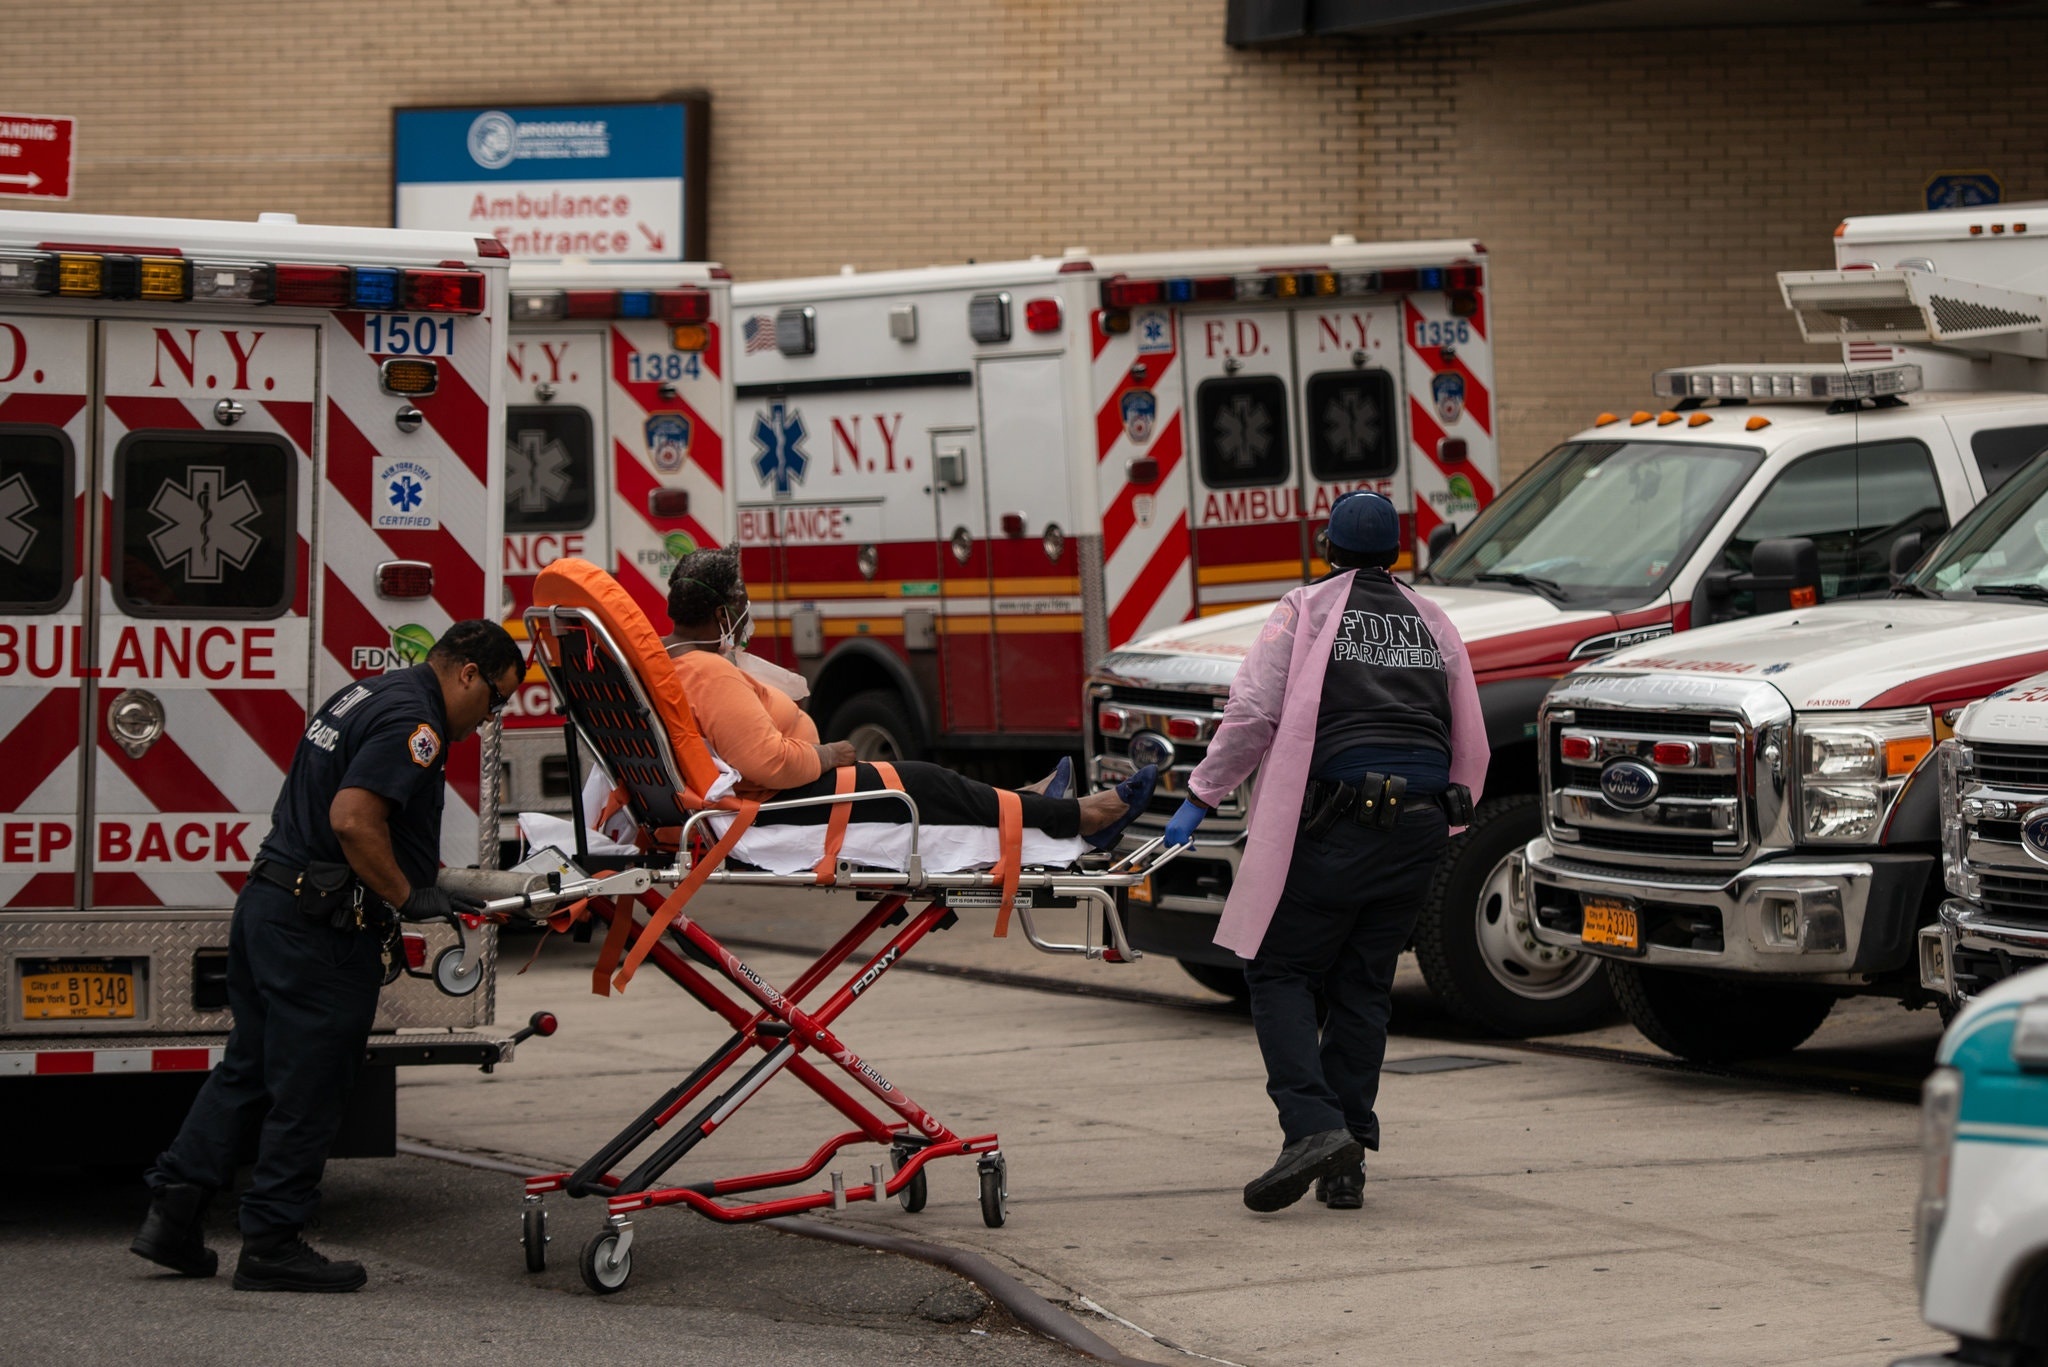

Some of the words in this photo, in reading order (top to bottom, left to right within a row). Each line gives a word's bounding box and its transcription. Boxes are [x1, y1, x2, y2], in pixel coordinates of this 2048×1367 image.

[470, 191, 630, 220] Ambulance
[493, 227, 630, 255] Entrance
[365, 314, 454, 356] 1501
[1204, 318, 1270, 358] F.D.
[1318, 312, 1381, 352] N.Y.
[1416, 320, 1470, 346] 1356
[150, 328, 276, 391] N.Y.
[507, 342, 578, 383] N.Y.
[629, 353, 701, 381] 1384
[830, 412, 914, 475] N.Y.
[381, 466, 395, 480] NEW
[395, 462, 413, 470] YORK
[414, 464, 431, 481] STATE
[1204, 481, 1392, 523] AMBULAE
[378, 515, 431, 527] CERTIFIED
[740, 508, 843, 541] BULANCE
[354, 648, 419, 668] FDNY
[1806, 699, 1851, 707] FA13095
[1988, 714, 2048, 729] SUP
[1609, 768, 1640, 794] Ford
[98, 822, 251, 863] BACK
[48, 964, 75, 973] NEW
[79, 963, 105, 973] YORK
[852, 945, 899, 996] FDNY
[26, 995, 45, 1004] New
[46, 994, 66, 1004] York
[31, 981, 48, 992] City
[50, 981, 59, 990] of
[83, 977, 128, 1007] 1348
[855, 1058, 894, 1093] FERNO
